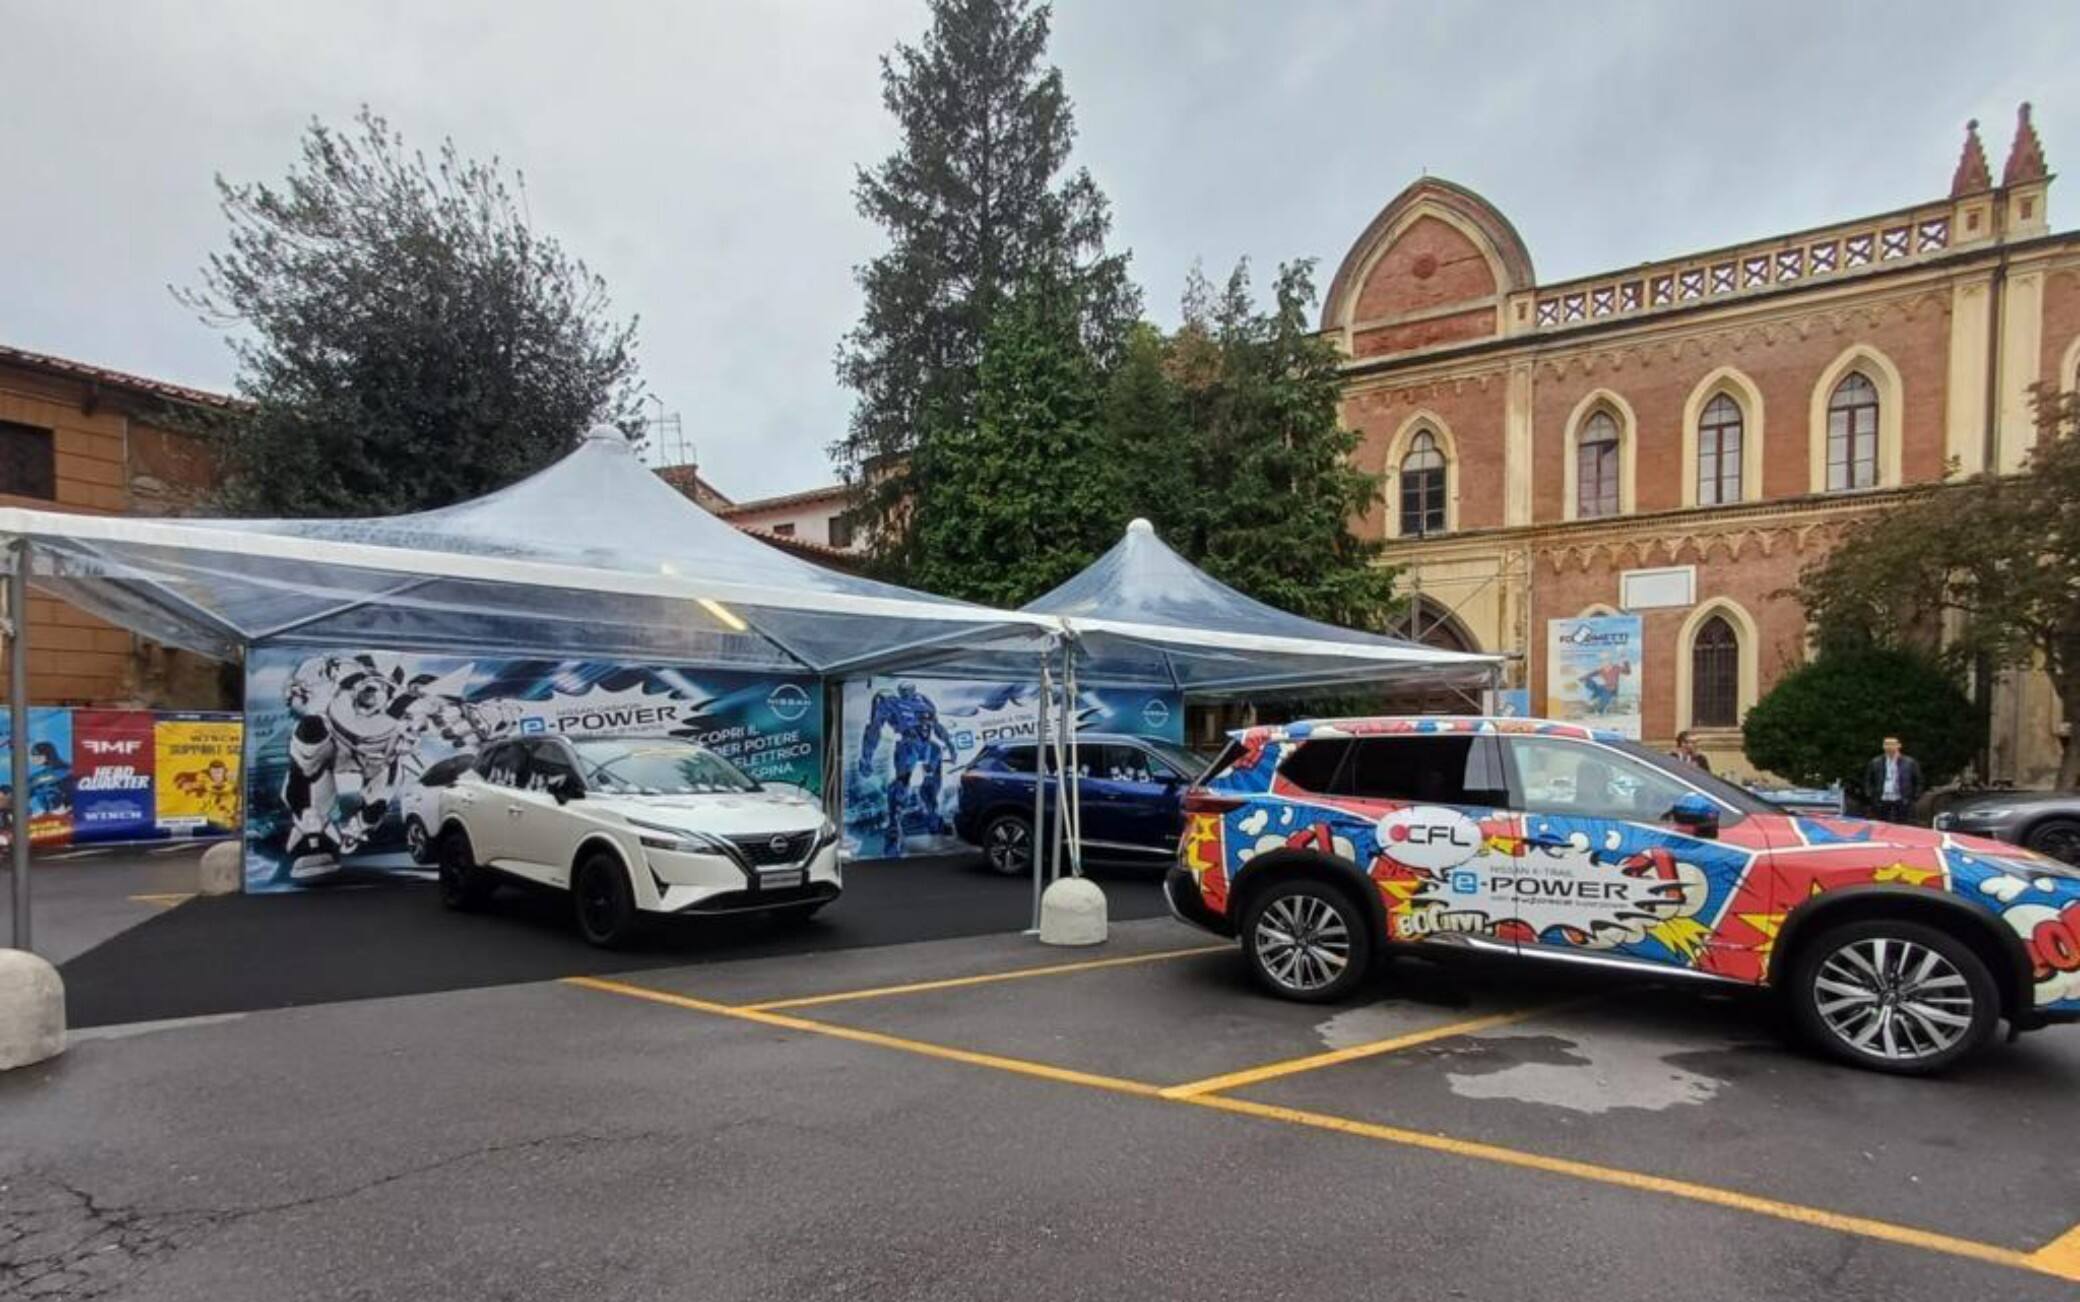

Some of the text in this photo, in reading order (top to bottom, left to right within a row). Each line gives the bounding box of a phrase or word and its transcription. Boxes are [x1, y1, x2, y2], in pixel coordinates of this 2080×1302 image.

[519, 706, 677, 736] e-POWER
[697, 726, 745, 746] COPRI
[745, 731, 800, 752] POTERE
[1404, 824, 1472, 848] CFL
[1452, 871, 1630, 901] e-POWER
